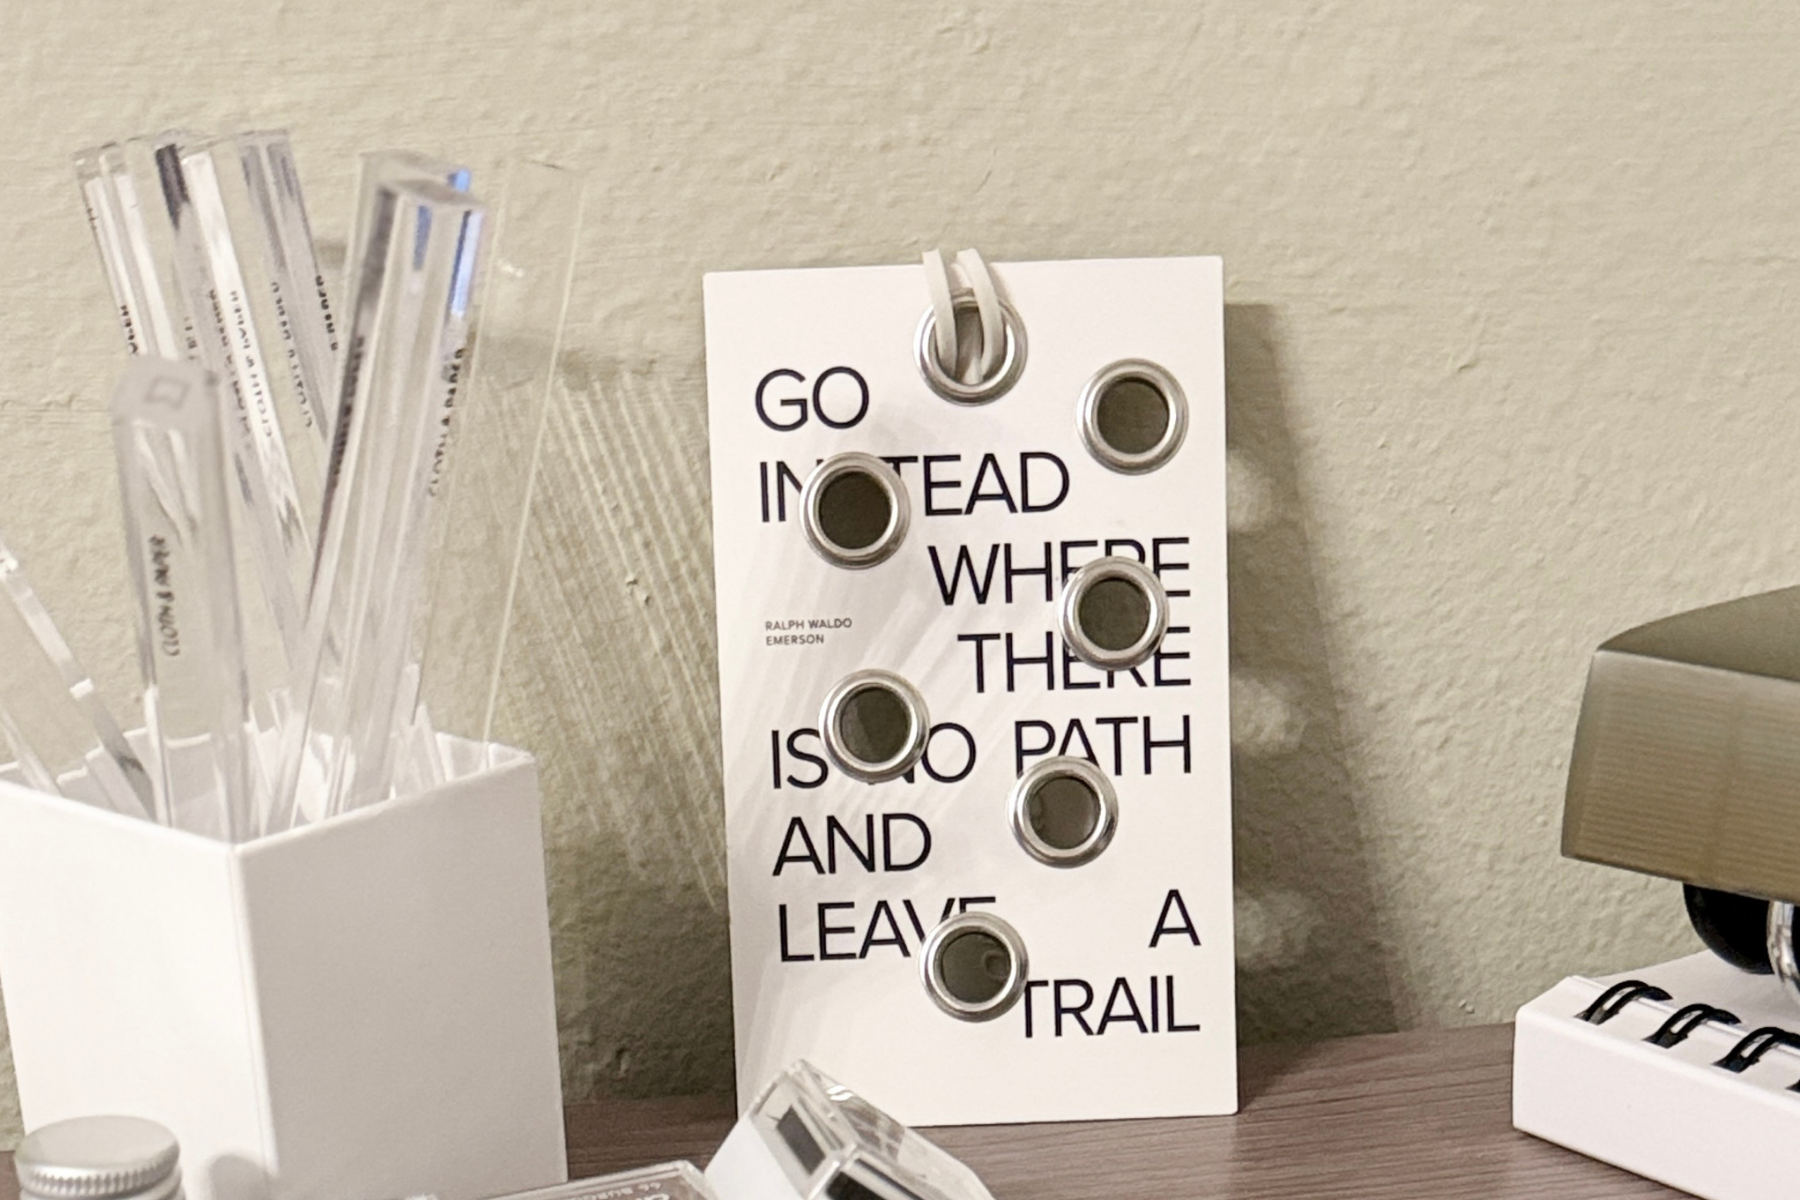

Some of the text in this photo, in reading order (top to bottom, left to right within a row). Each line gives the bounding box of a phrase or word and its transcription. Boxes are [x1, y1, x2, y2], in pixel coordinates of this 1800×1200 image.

[755, 366, 869, 431] GO
[759, 451, 1070, 523] INEAD
[765, 618, 852, 631] RALPH WALDO
[766, 634, 824, 646] EMERSON
[771, 728, 829, 789] IS
[772, 812, 932, 876] AND
[1148, 889, 1201, 947] A
[1024, 975, 1200, 1038] TRAIL
